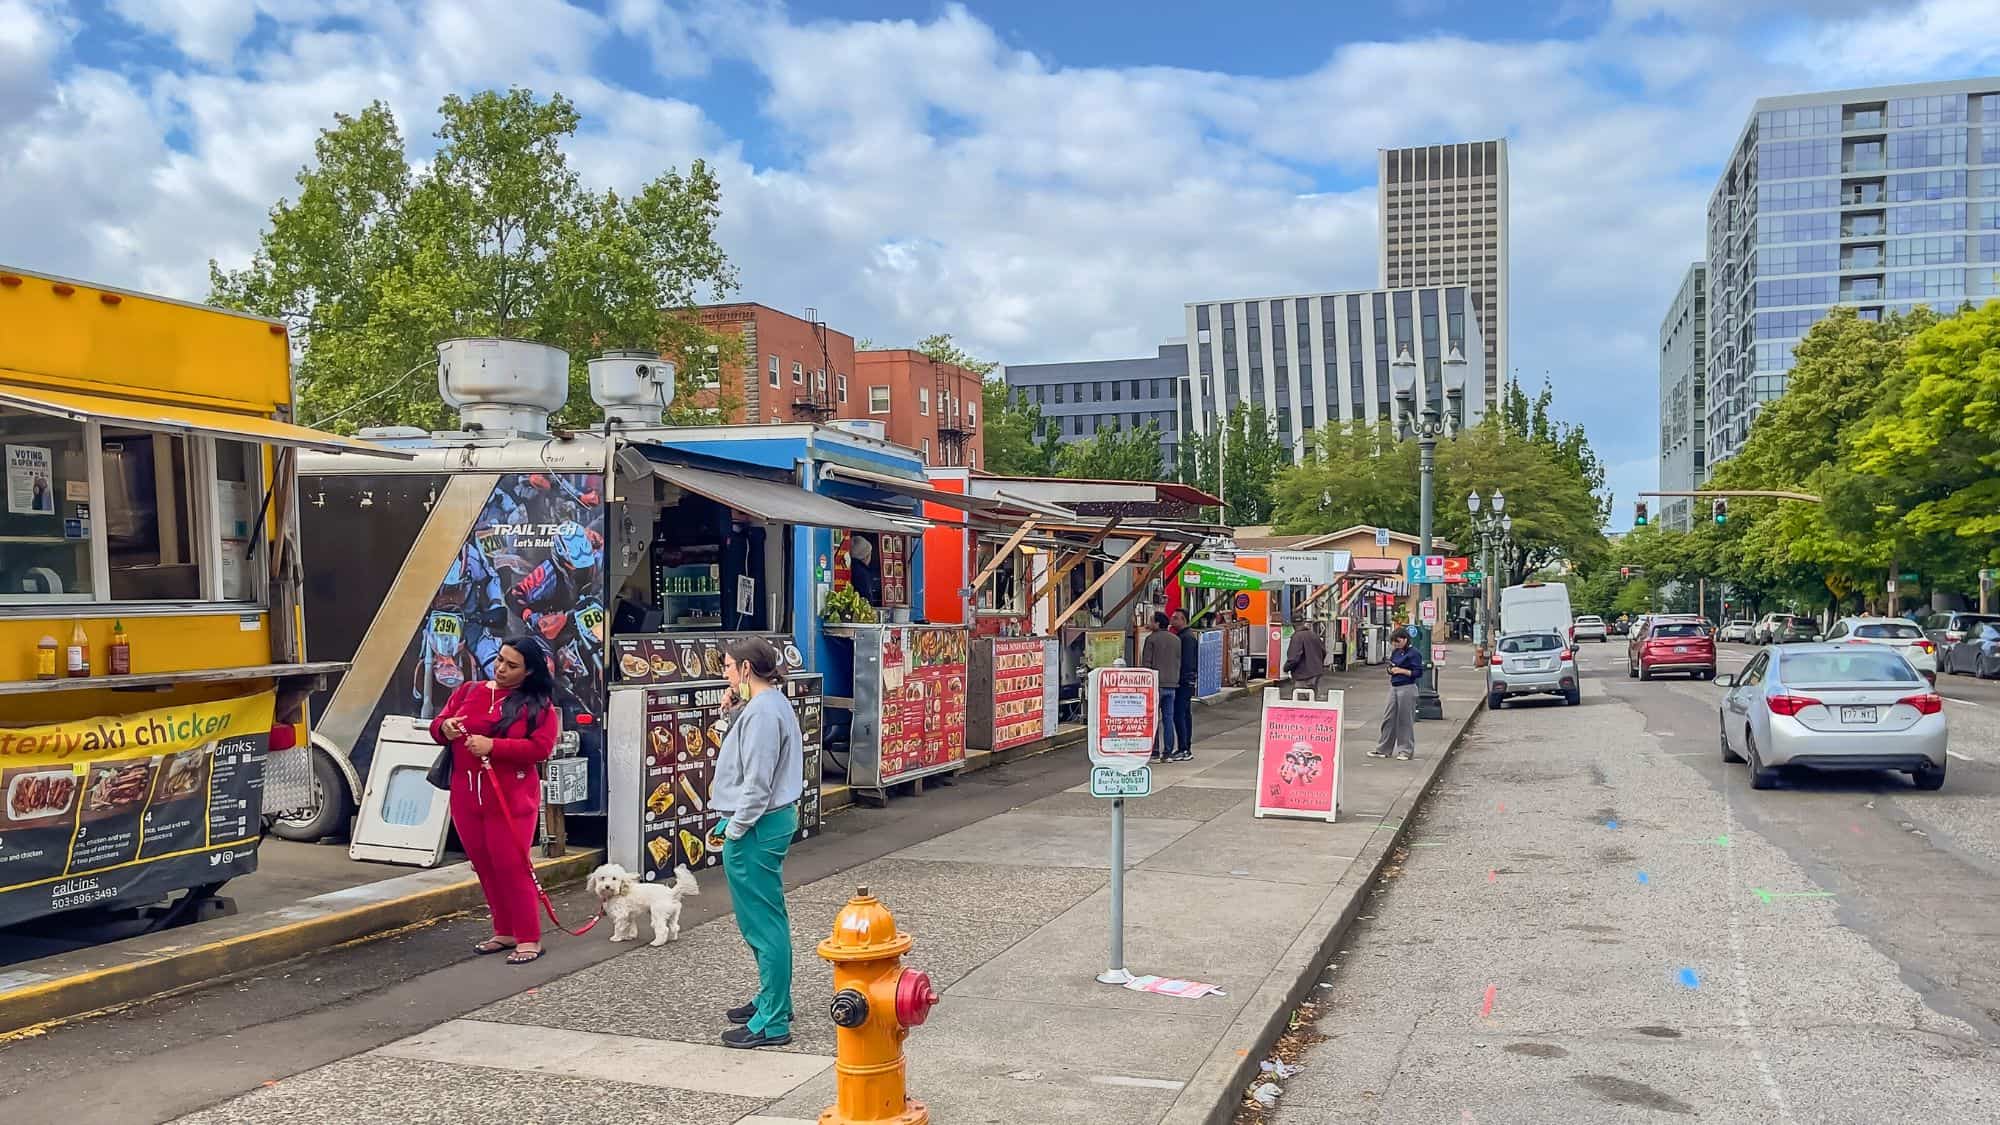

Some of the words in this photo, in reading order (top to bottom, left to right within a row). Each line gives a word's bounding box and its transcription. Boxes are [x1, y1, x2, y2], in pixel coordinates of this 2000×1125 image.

[15, 450, 43, 460] VOTING
[492, 524, 535, 536] TRAIL
[537, 524, 577, 536] TECH
[513, 538, 534, 547] Let's
[535, 538, 555, 547] Ride
[1103, 672, 1117, 687] NO
[1119, 674, 1152, 686] PARKING
[0, 722, 126, 758] teriyaki
[135, 712, 231, 745] chicken
[215, 740, 256, 756] drinks:
[78, 828, 87, 838] 3
[52, 876, 99, 896] call-ins:
[52, 887, 118, 910] 503-896-3493
